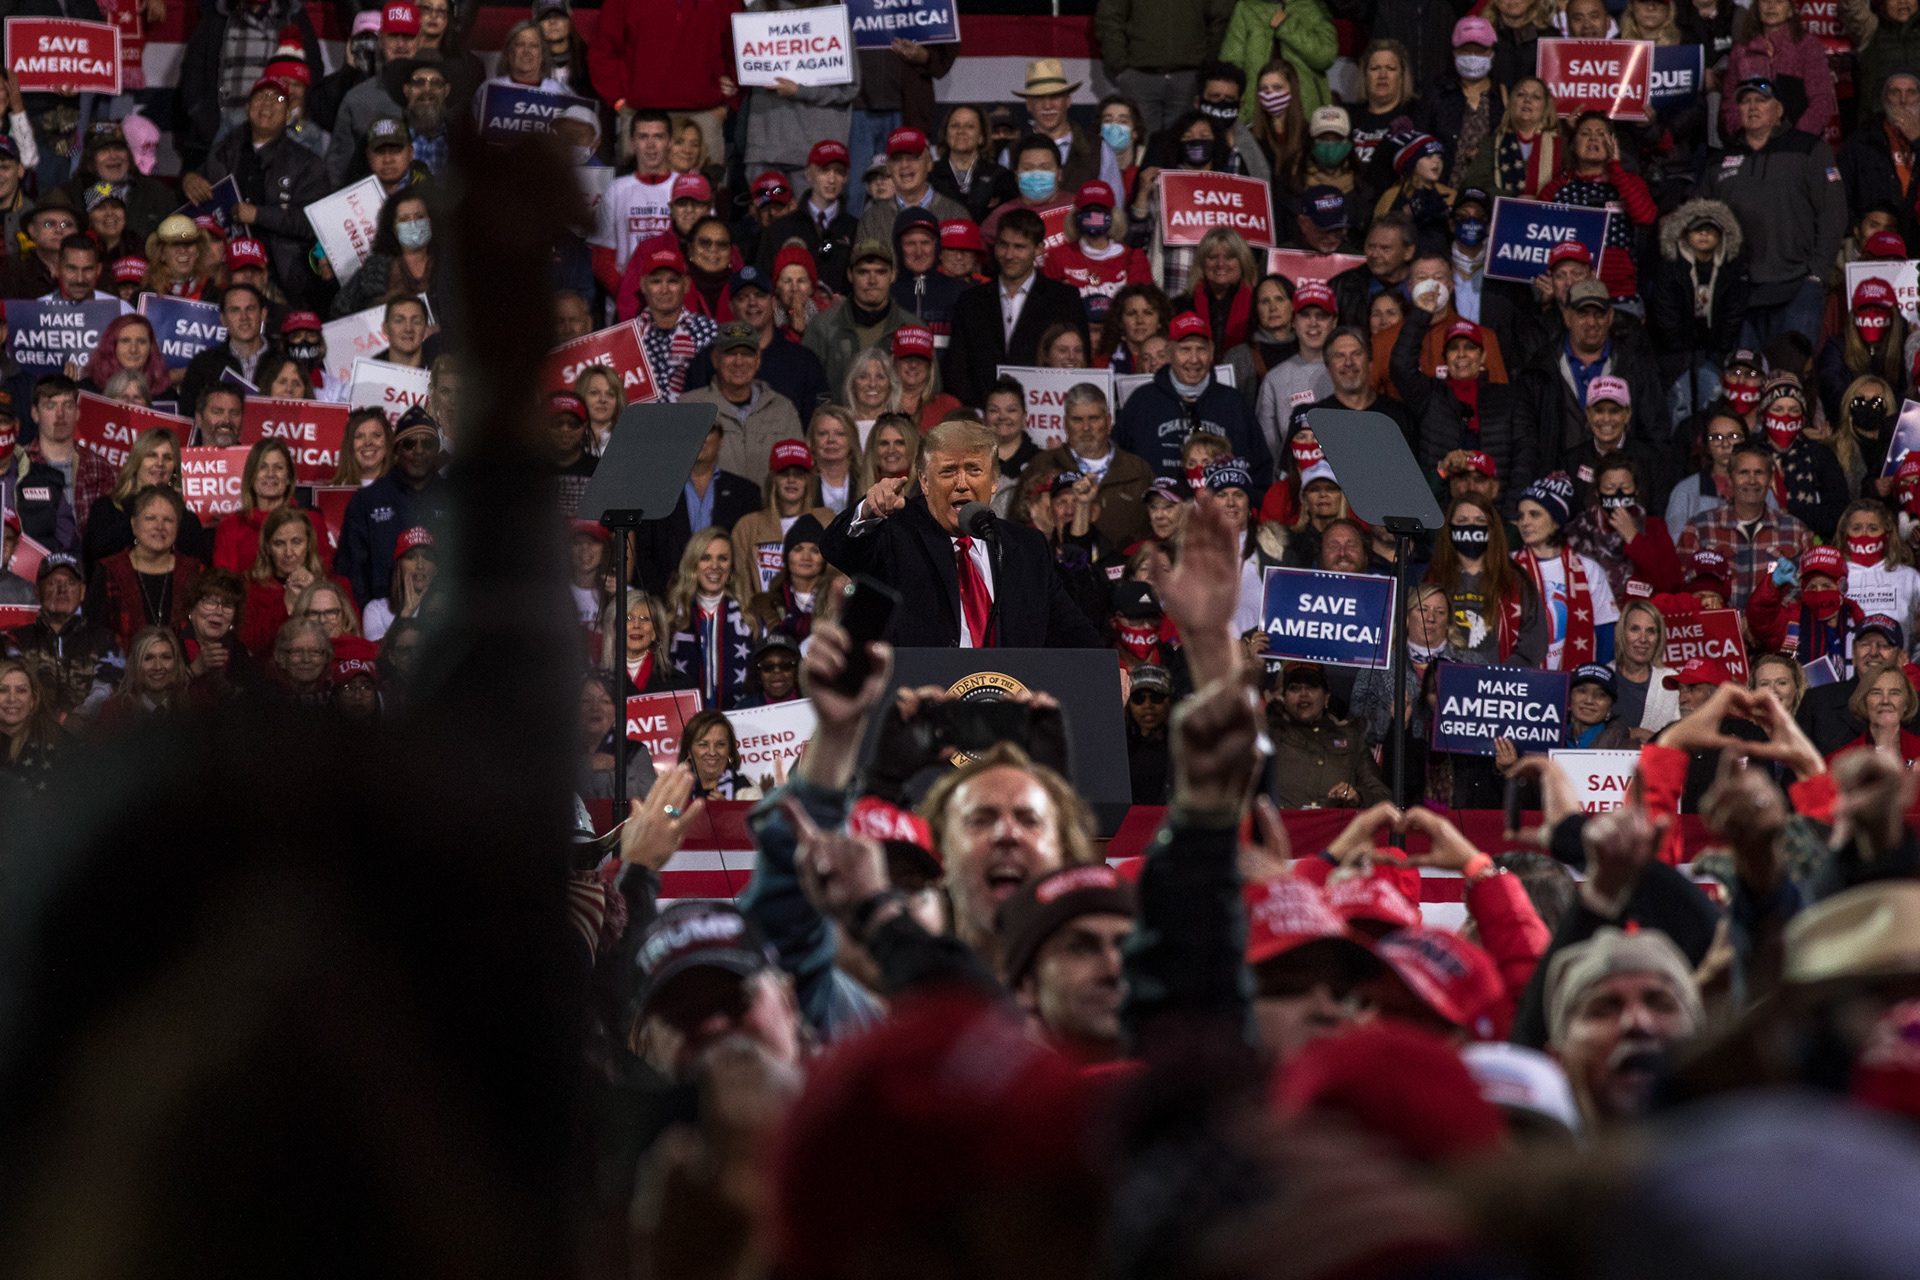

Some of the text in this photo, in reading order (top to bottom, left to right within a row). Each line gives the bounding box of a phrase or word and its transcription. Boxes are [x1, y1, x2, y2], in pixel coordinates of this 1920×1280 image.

[388, 8, 412, 22] USA
[853, 10, 948, 31] AMERICA!
[769, 22, 811, 36] MAKE
[38, 36, 89, 54] SAVE
[742, 37, 842, 56] AMERICA
[14, 56, 112, 76] AMERICA!
[743, 56, 843, 72] GREAT AGAIN
[1569, 60, 1620, 76] SAVE
[1547, 82, 1642, 99] AMERICA!
[1193, 190, 1243, 208] SAVE
[1171, 211, 1266, 231] AMERICA!
[1526, 223, 1577, 241] SAVE
[232, 242, 261, 257] USA
[39, 313, 84, 327] MAKE
[13, 330, 98, 348] AMERIC
[175, 319, 228, 342] SAVE
[15, 350, 58, 365] GREAT
[262, 420, 317, 441] SAVE
[1765, 417, 1800, 432] MAGA
[182, 460, 226, 474] MAKE
[1600, 497, 1635, 509] MAGA
[1450, 531, 1488, 542] MAGA
[1847, 540, 1883, 554] MAGA
[1694, 551, 1723, 562] TRUMP
[1298, 593, 1356, 616] SAVE
[1268, 617, 1381, 645] AMERICA!
[340, 659, 371, 673] USA
[989, 676, 999, 685] OF
[1000, 678, 1014, 691] THE
[1478, 679, 1528, 697] MAKE
[1442, 696, 1560, 723] AMERICA
[1440, 720, 1560, 743] GREAT AGAIN
